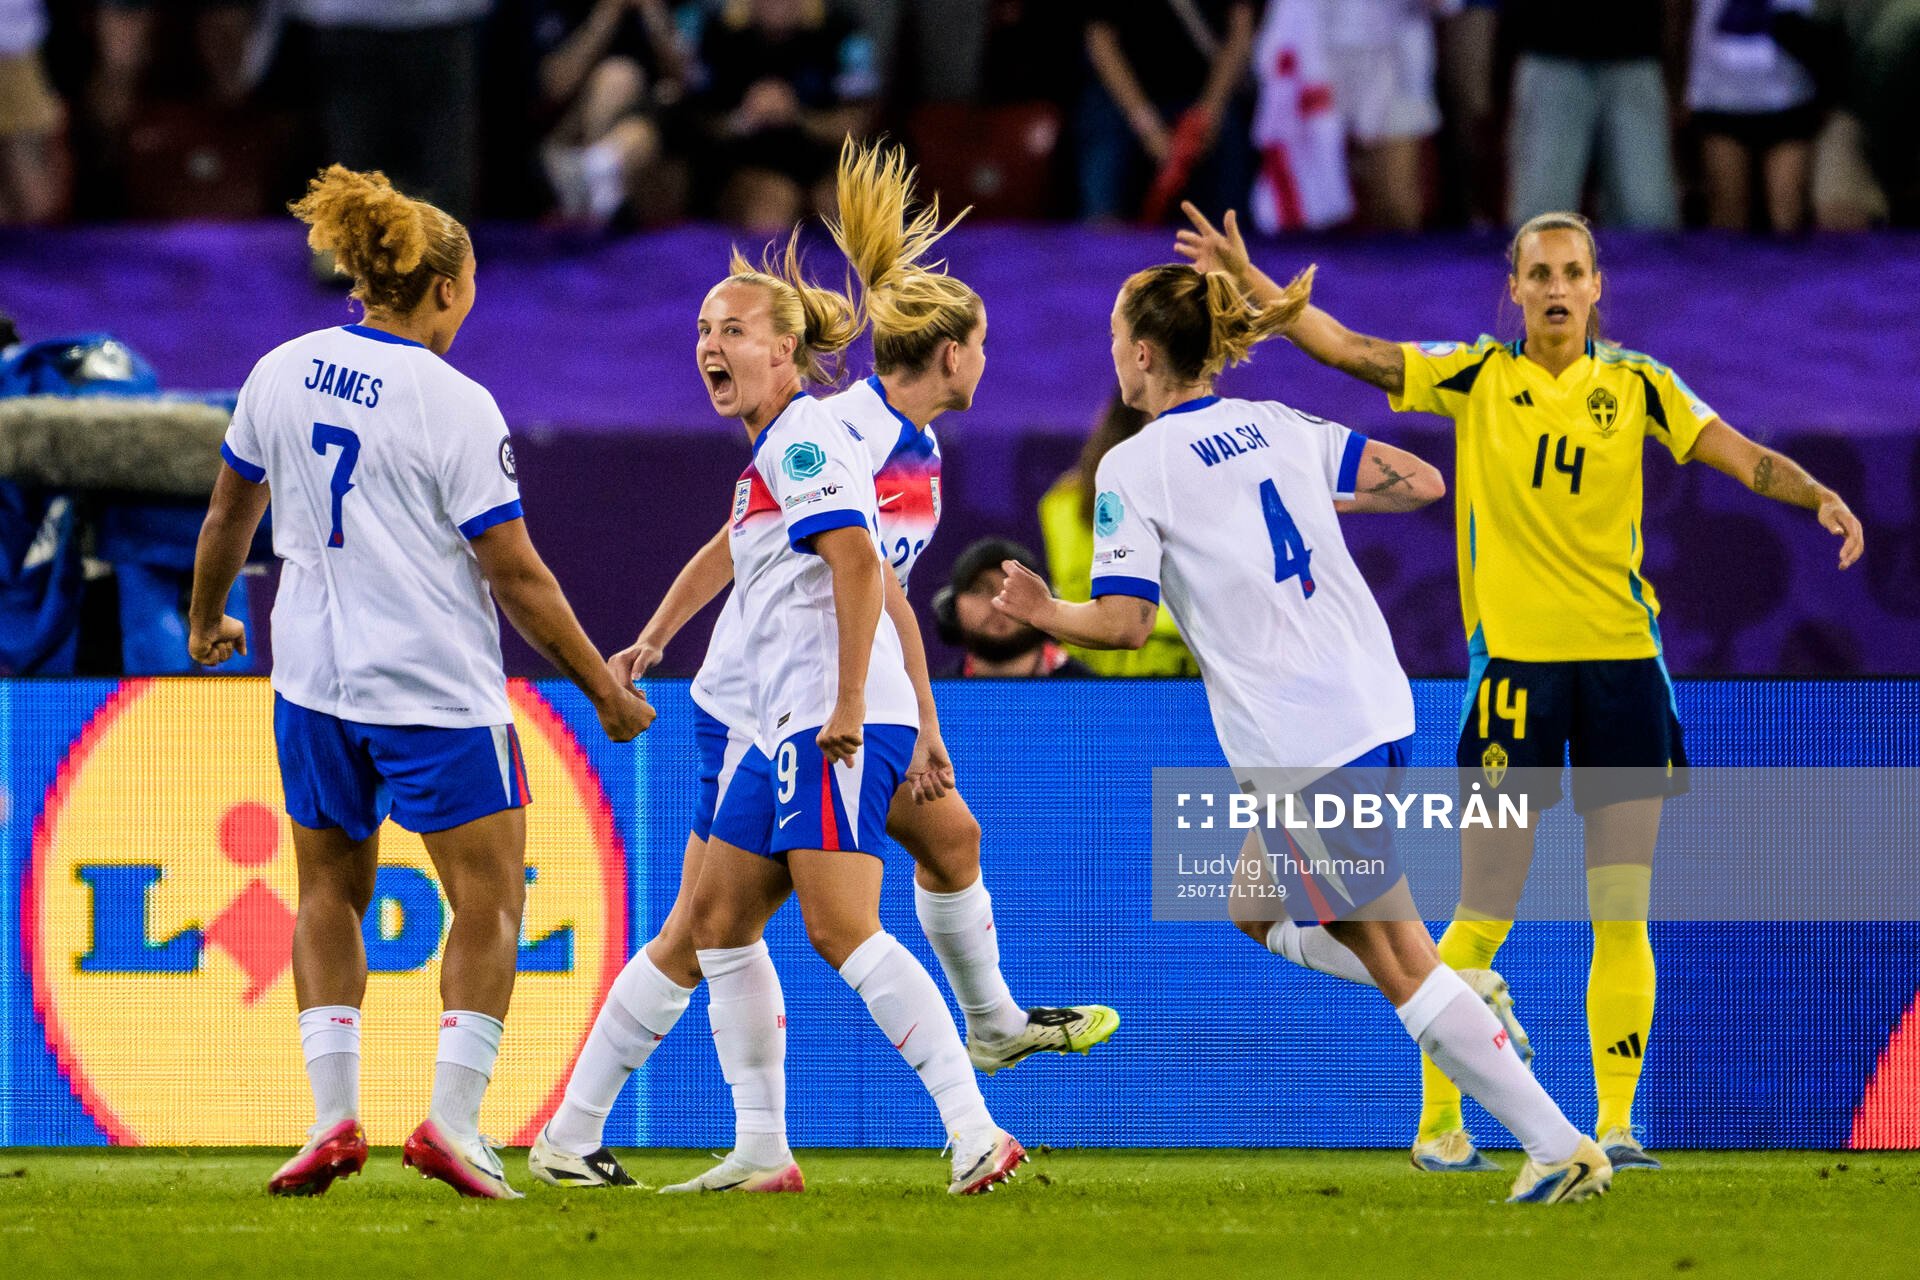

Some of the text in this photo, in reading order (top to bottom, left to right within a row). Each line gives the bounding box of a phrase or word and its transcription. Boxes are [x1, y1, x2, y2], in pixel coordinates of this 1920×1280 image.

[304, 358, 383, 409] JAMES
[1189, 423, 1270, 467] WALSH
[1531, 433, 1586, 495] 14
[311, 421, 362, 549] 7
[892, 536, 925, 569] 2
[1259, 477, 1317, 600] 4
[1478, 677, 1528, 739] 14
[777, 741, 798, 805] 9
